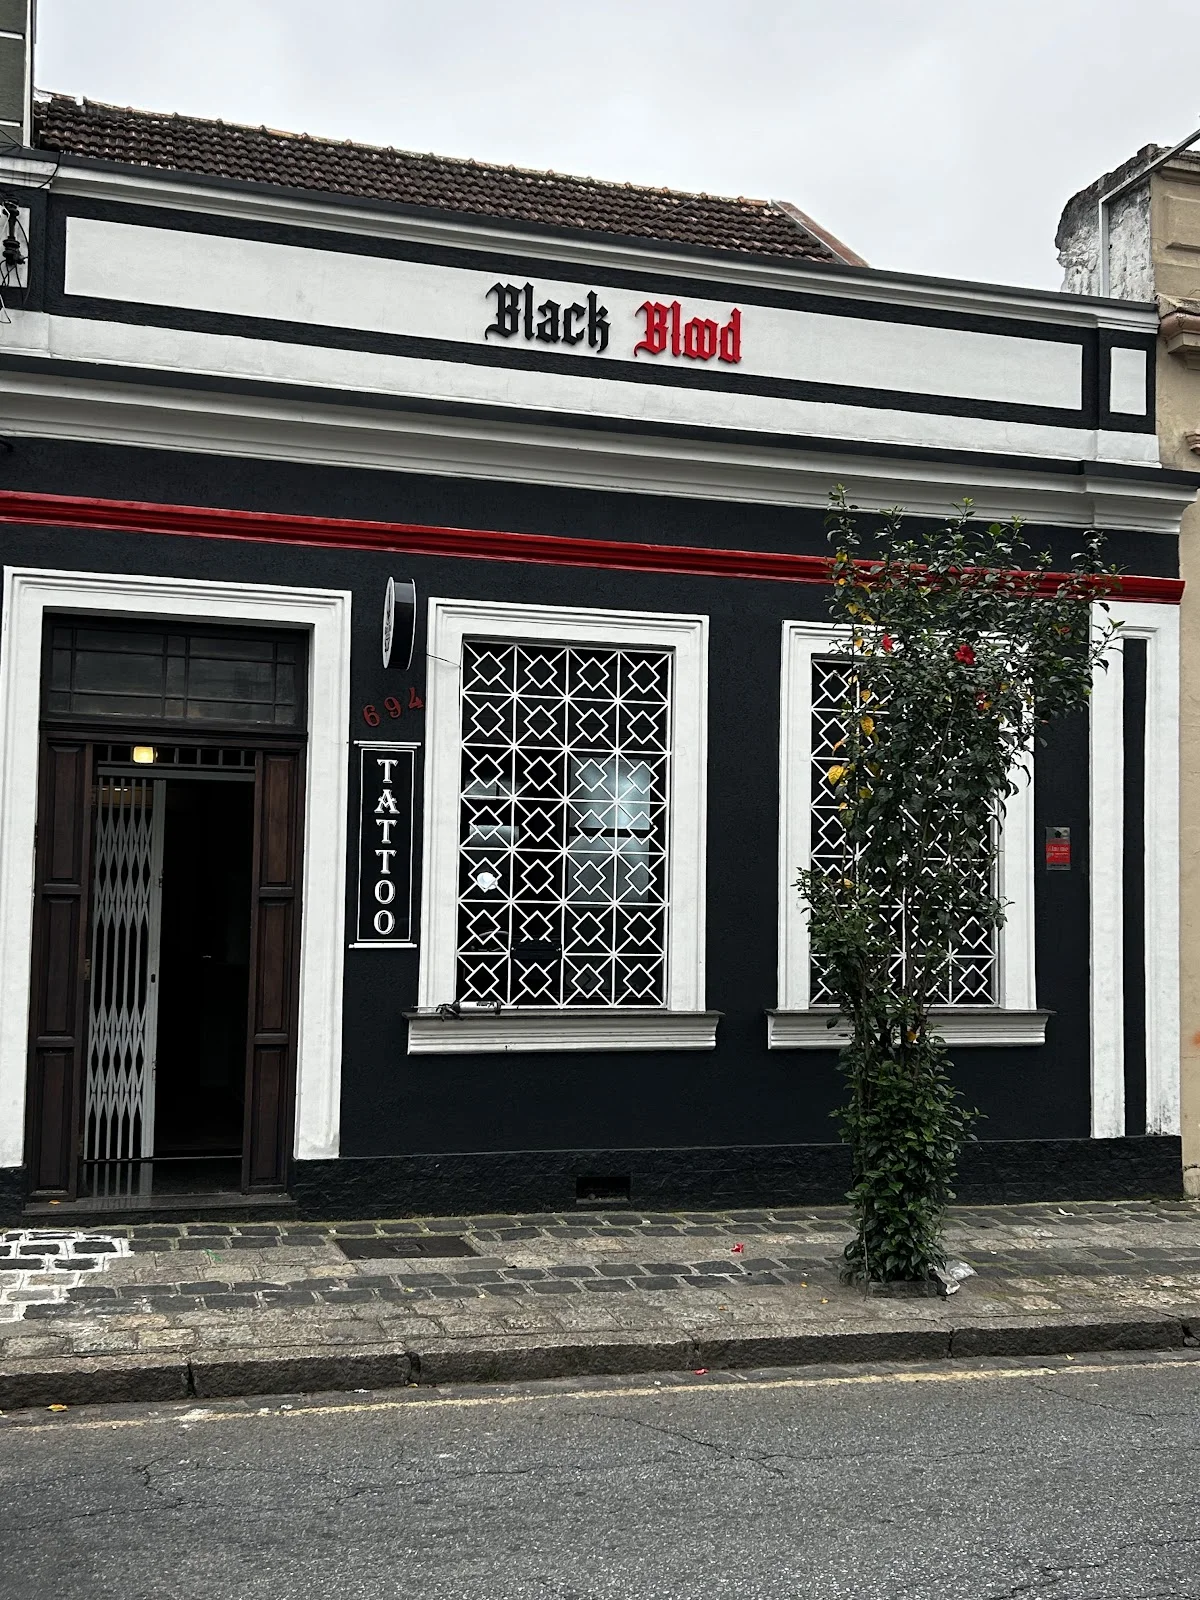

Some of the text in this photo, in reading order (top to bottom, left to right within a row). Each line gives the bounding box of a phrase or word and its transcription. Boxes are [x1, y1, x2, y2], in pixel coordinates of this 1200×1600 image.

[484, 281, 743, 365] Black Blood
[362, 687, 425, 727] 694
[373, 758, 401, 935] TATTOO
